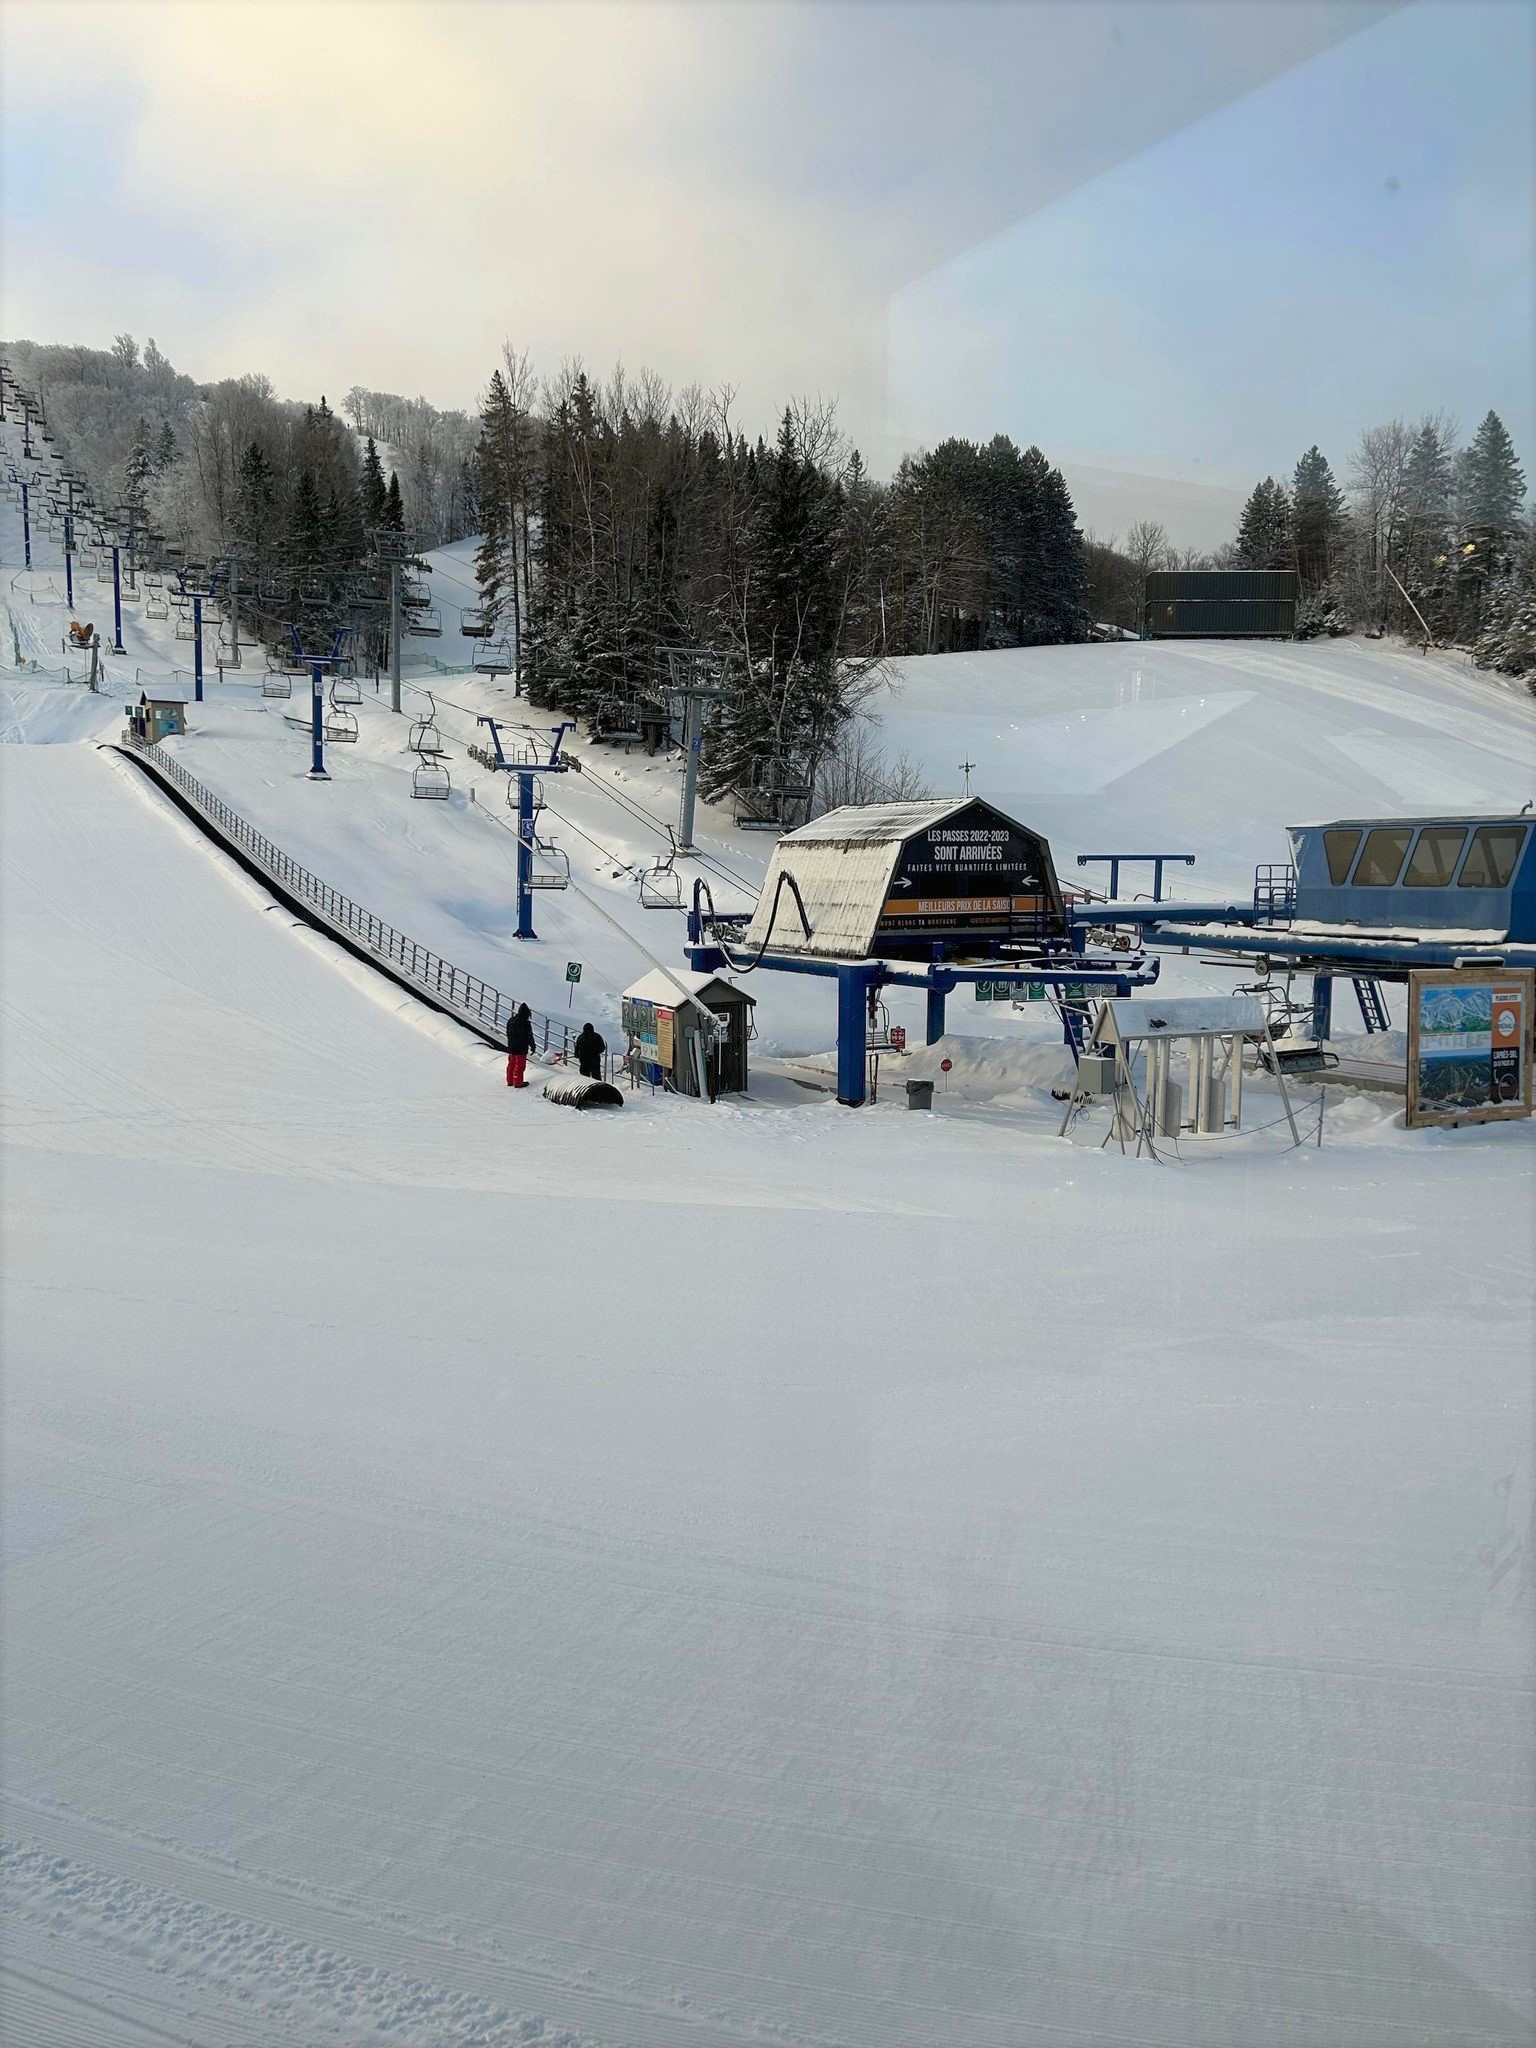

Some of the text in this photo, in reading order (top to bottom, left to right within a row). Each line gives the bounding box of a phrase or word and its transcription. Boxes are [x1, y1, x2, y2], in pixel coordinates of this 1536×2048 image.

[927, 830, 1010, 841] LES PASSES 2022-2023
[934, 843, 1002, 860] SONT ARRIVÉES
[907, 864, 933, 872] FAITES
[955, 863, 993, 871] QUANTITÉS
[995, 863, 1027, 871] LIMITÉES
[918, 901, 956, 912] MEILLEURS
[956, 900, 972, 911] PRIX
[973, 900, 982, 910] DE
[982, 900, 991, 910] LA
